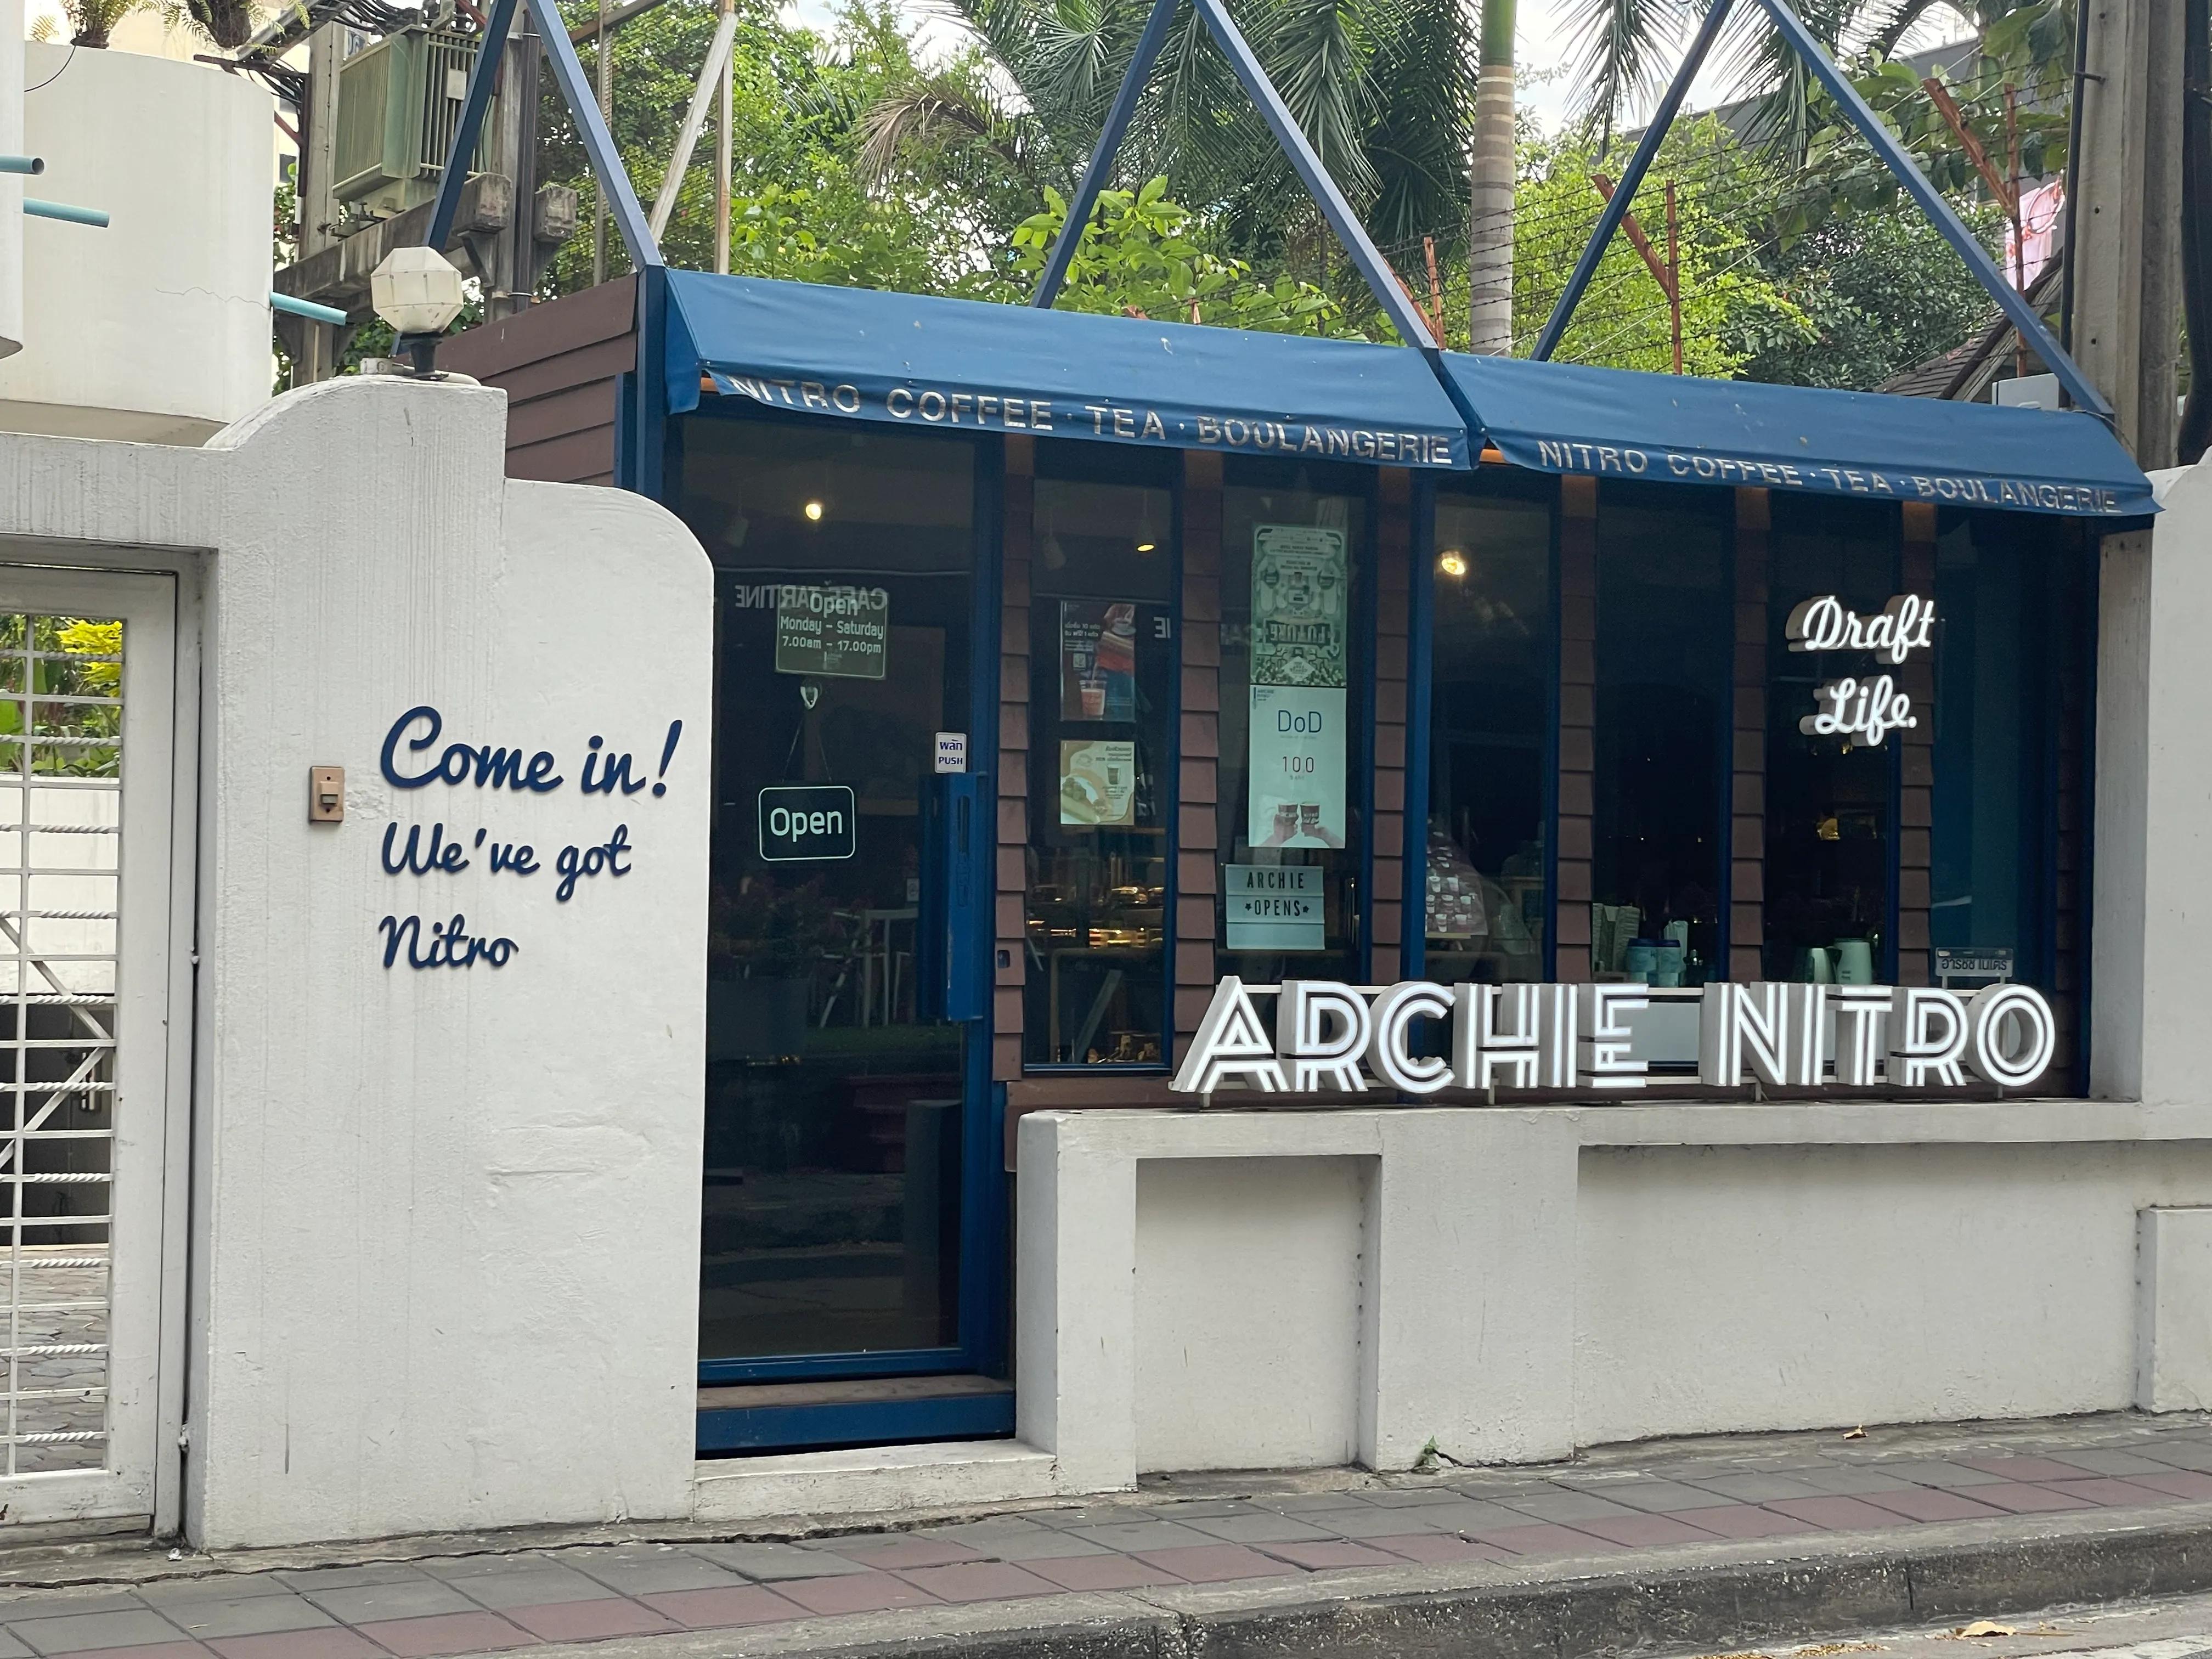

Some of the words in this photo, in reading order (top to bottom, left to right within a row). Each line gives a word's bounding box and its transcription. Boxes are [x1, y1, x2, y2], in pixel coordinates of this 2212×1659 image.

[726, 375, 861, 413] NITRO
[886, 388, 1053, 431] COFFEE
[1085, 405, 1166, 440] TEA
[1197, 416, 1453, 465] BOULANGERIE
[1537, 440, 1648, 473] NITRO
[1667, 454, 1803, 486] COFFEE
[1820, 468, 1893, 494] TEA
[1911, 476, 2123, 514] BOULANGERIE
[810, 593, 858, 618] Open
[780, 616, 822, 635] Monday
[837, 620, 884, 640] Saturday
[782, 636, 821, 649] 7.00am
[837, 640, 881, 655] 17.00pm
[1803, 594, 1934, 664] Draft
[1278, 710, 1322, 733] DoD
[381, 706, 563, 792] Come
[581, 720, 682, 797] in!
[1283, 757, 1314, 773] 100
[770, 808, 842, 842] Open
[382, 822, 540, 875] We've
[556, 824, 631, 902] got
[1246, 872, 1305, 889] ARCHIE
[379, 914, 519, 969] Nitro
[1173, 975, 1649, 1093] ARCHIE
[1701, 983, 2057, 1088] NITRO
